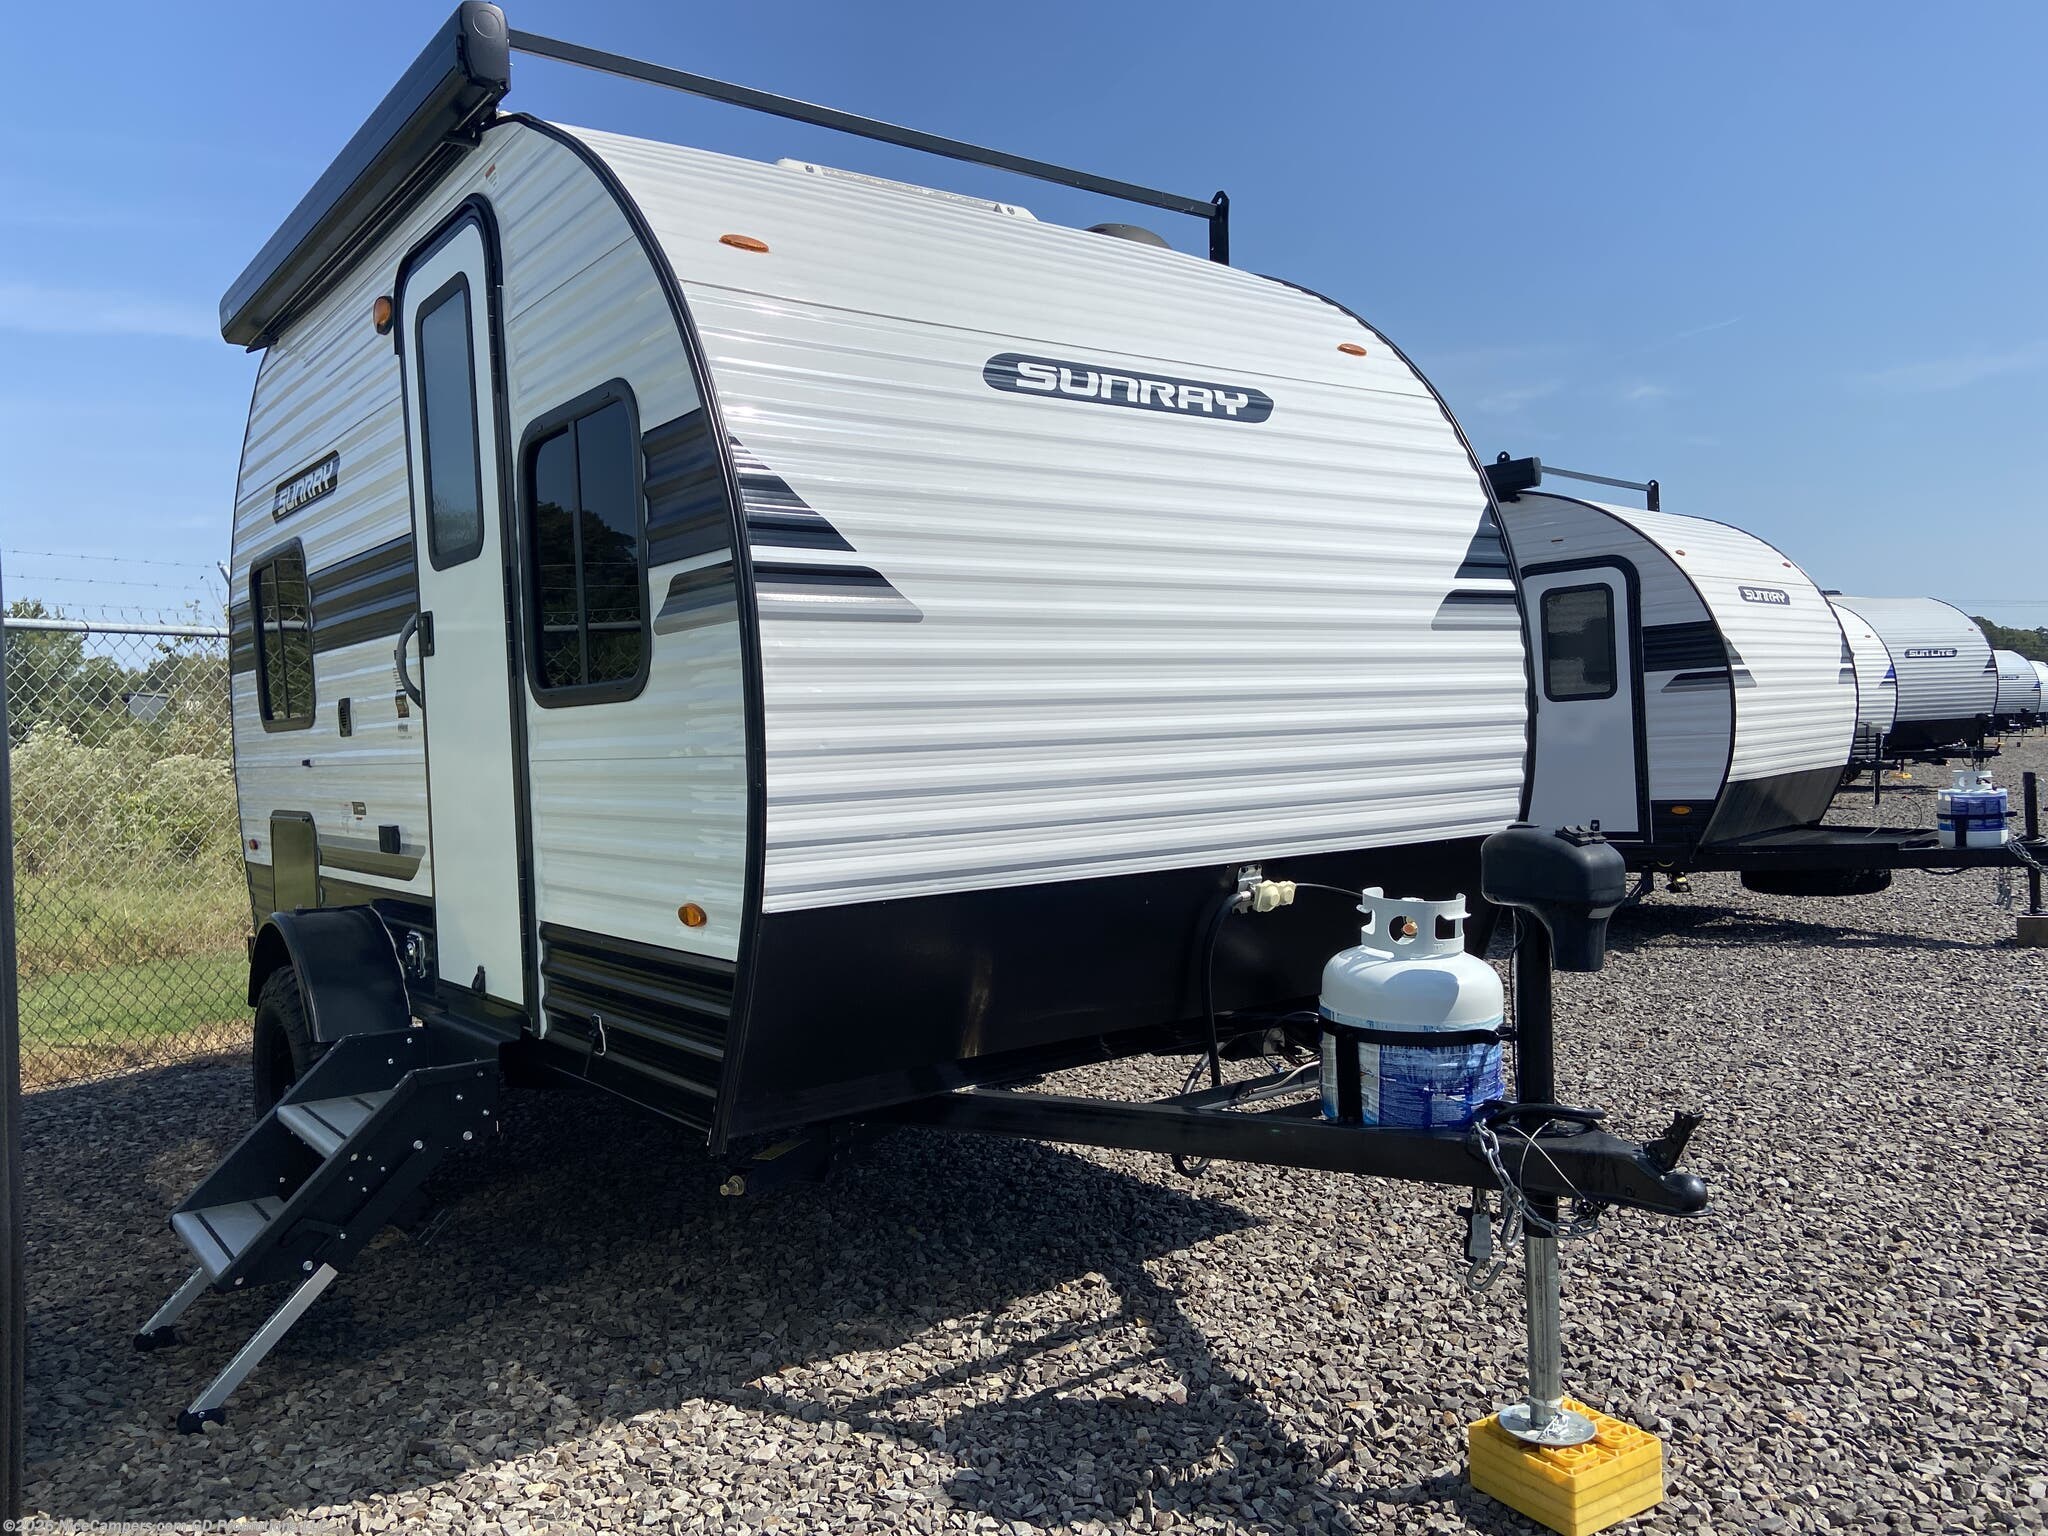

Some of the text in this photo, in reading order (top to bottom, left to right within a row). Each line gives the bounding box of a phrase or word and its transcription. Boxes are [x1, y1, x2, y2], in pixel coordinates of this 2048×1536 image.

[1015, 361, 1249, 416] SUNRAY
[277, 460, 334, 516] SUNRAY
[1742, 588, 1786, 604] SUNRAY
